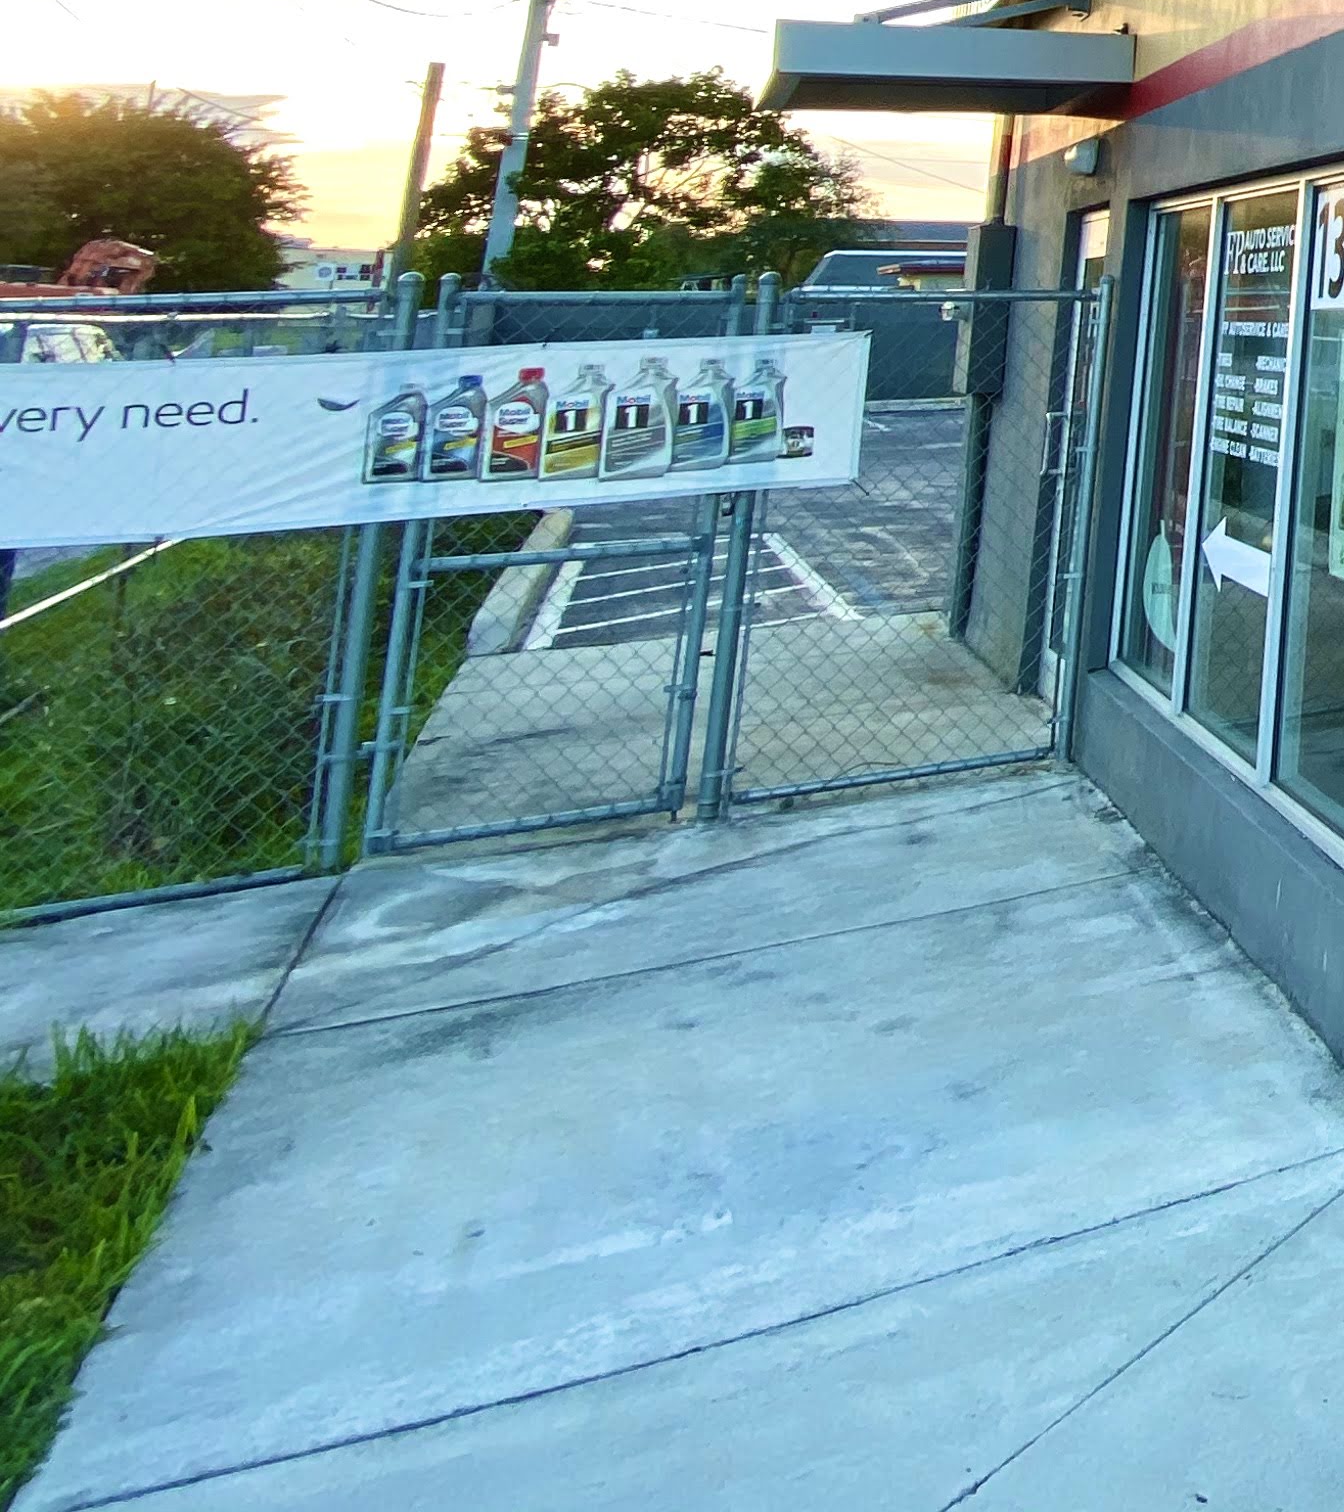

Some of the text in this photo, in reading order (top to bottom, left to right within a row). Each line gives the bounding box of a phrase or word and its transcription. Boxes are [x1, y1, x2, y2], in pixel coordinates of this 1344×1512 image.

[1224, 231, 1245, 275] FP
[1244, 228, 1266, 250] AUTO
[1270, 250, 1285, 272] LLC
[121, 388, 259, 429] need.
[556, 399, 589, 409] Mobil
[616, 394, 651, 405] Mobil
[499, 408, 531, 417] Mobil
[564, 410, 576, 431] 1
[624, 405, 638, 428] 1
[687, 403, 699, 423] 1
